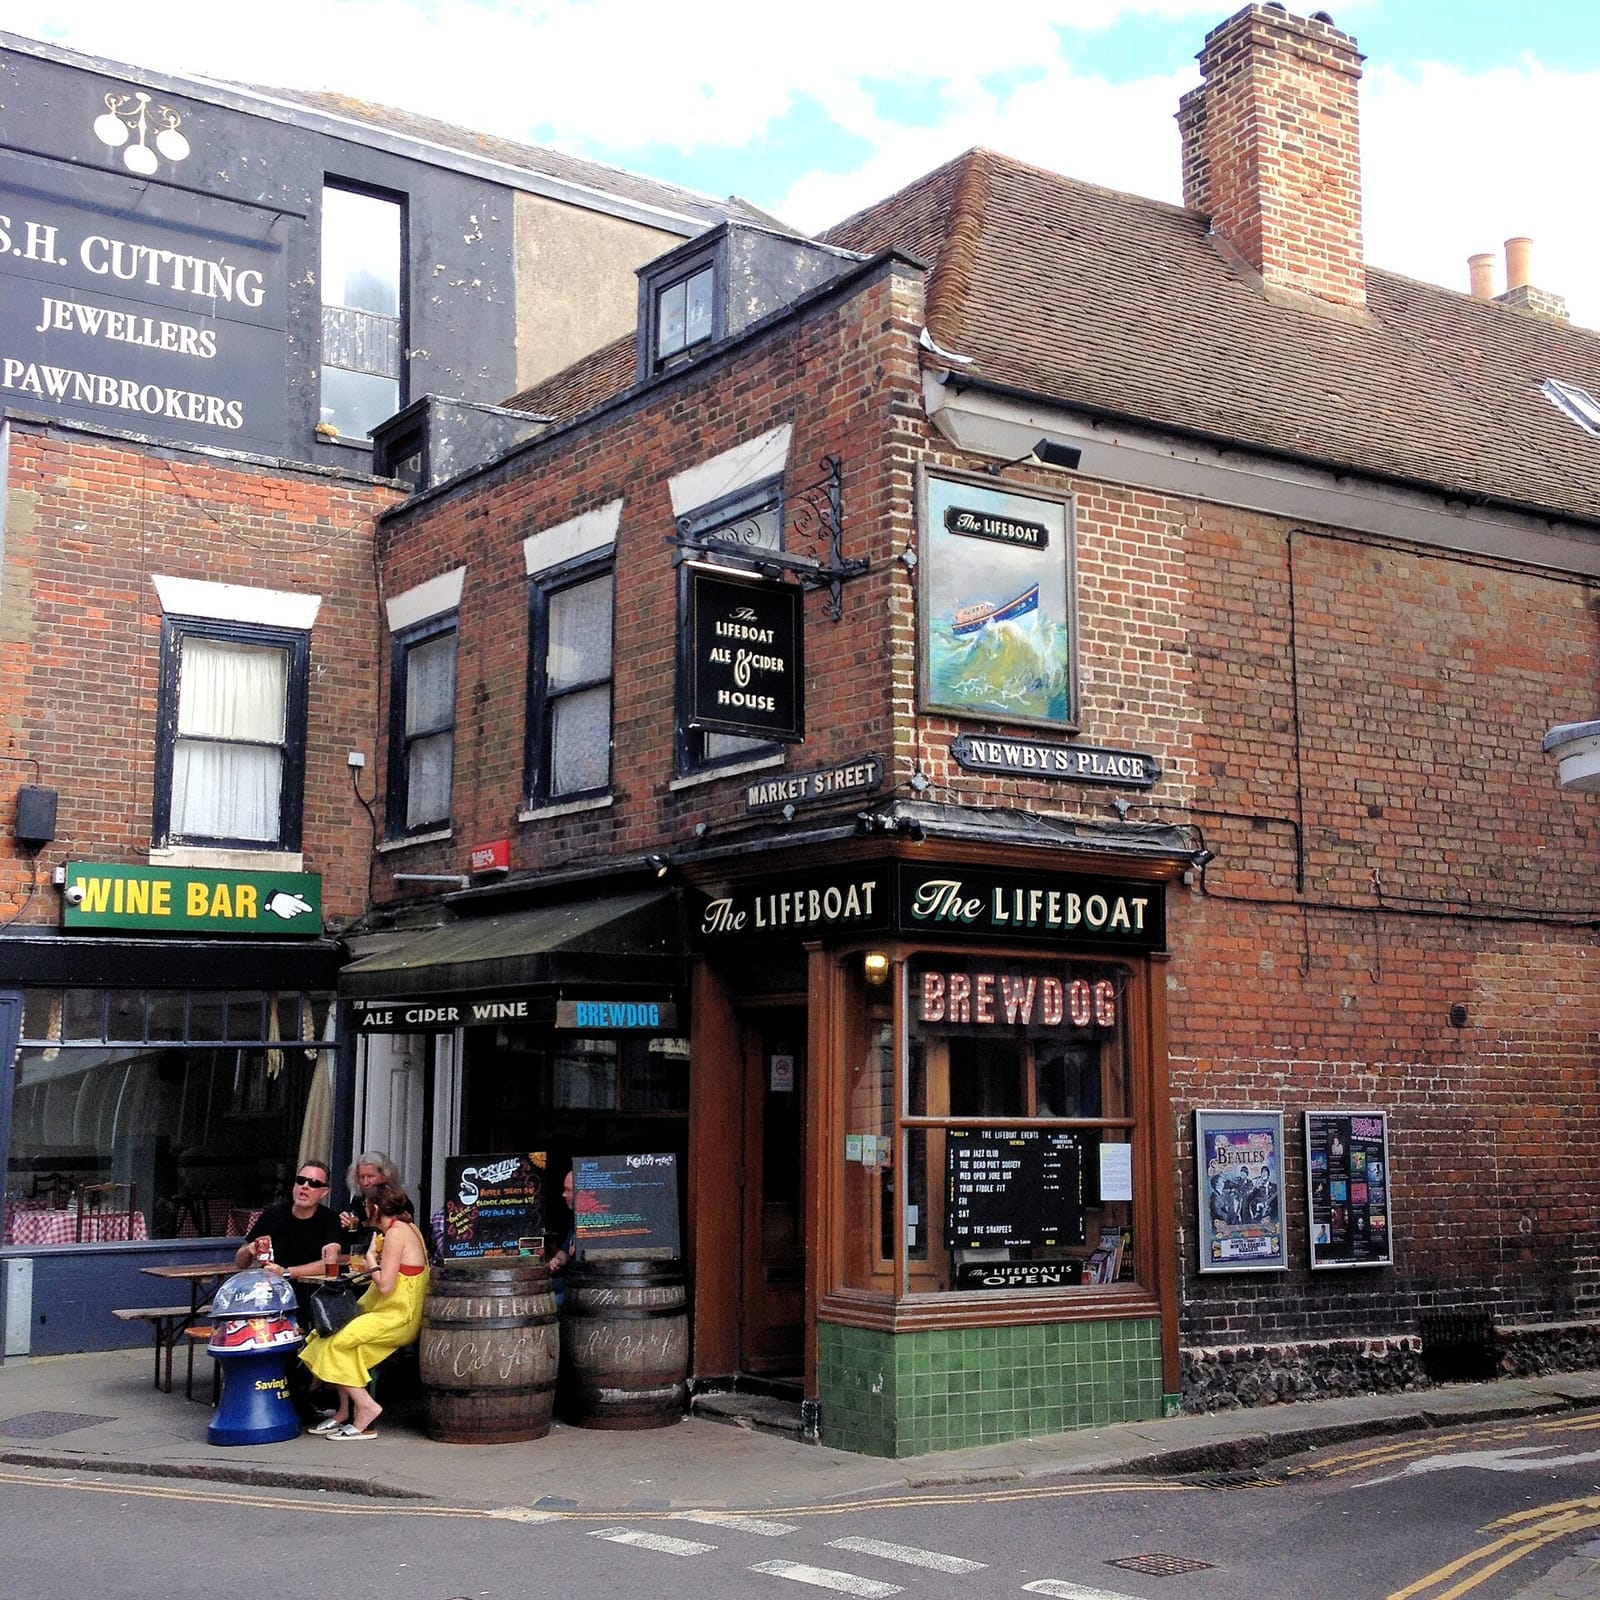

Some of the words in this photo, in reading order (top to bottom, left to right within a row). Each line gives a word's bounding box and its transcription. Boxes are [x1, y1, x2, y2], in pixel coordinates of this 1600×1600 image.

[0, 214, 67, 266] S.H.
[80, 234, 265, 307] CUTTING
[36, 297, 217, 359] JEWELLERS
[2, 358, 243, 429] PAWNBROKERS
[957, 514, 982, 530] The
[984, 519, 1039, 543] LIFEBOAT
[728, 606, 757, 621] The
[715, 621, 774, 643] LIFEBOAT
[709, 647, 731, 663] ALE
[733, 648, 753, 687] &
[752, 655, 784, 672] CIDER
[717, 690, 775, 711] HOUSE
[970, 740, 1068, 771] NEWBY'S
[1078, 755, 1144, 778] PLACE
[748, 778, 808, 805] MARKET
[814, 763, 876, 793] STREET
[77, 877, 171, 915] WINE
[187, 882, 257, 918] BAR
[702, 897, 747, 934] The
[755, 881, 876, 929] LIFEBOAT
[913, 879, 985, 923] The
[994, 887, 1148, 934] LIFEBOAT
[363, 1012, 393, 1026] ALE
[405, 1007, 459, 1023] CIDER
[472, 1001, 528, 1020] WINE
[576, 1003, 659, 1027] BREWDOG
[919, 971, 1116, 1028] BREWDOG
[1217, 1146, 1265, 1165] BEATLES
[983, 1274, 1060, 1285] OPEN
[993, 1266, 1056, 1275] LIFEBOAT
[1061, 1265, 1072, 1273] IS
[255, 1378, 285, 1390] Saving
